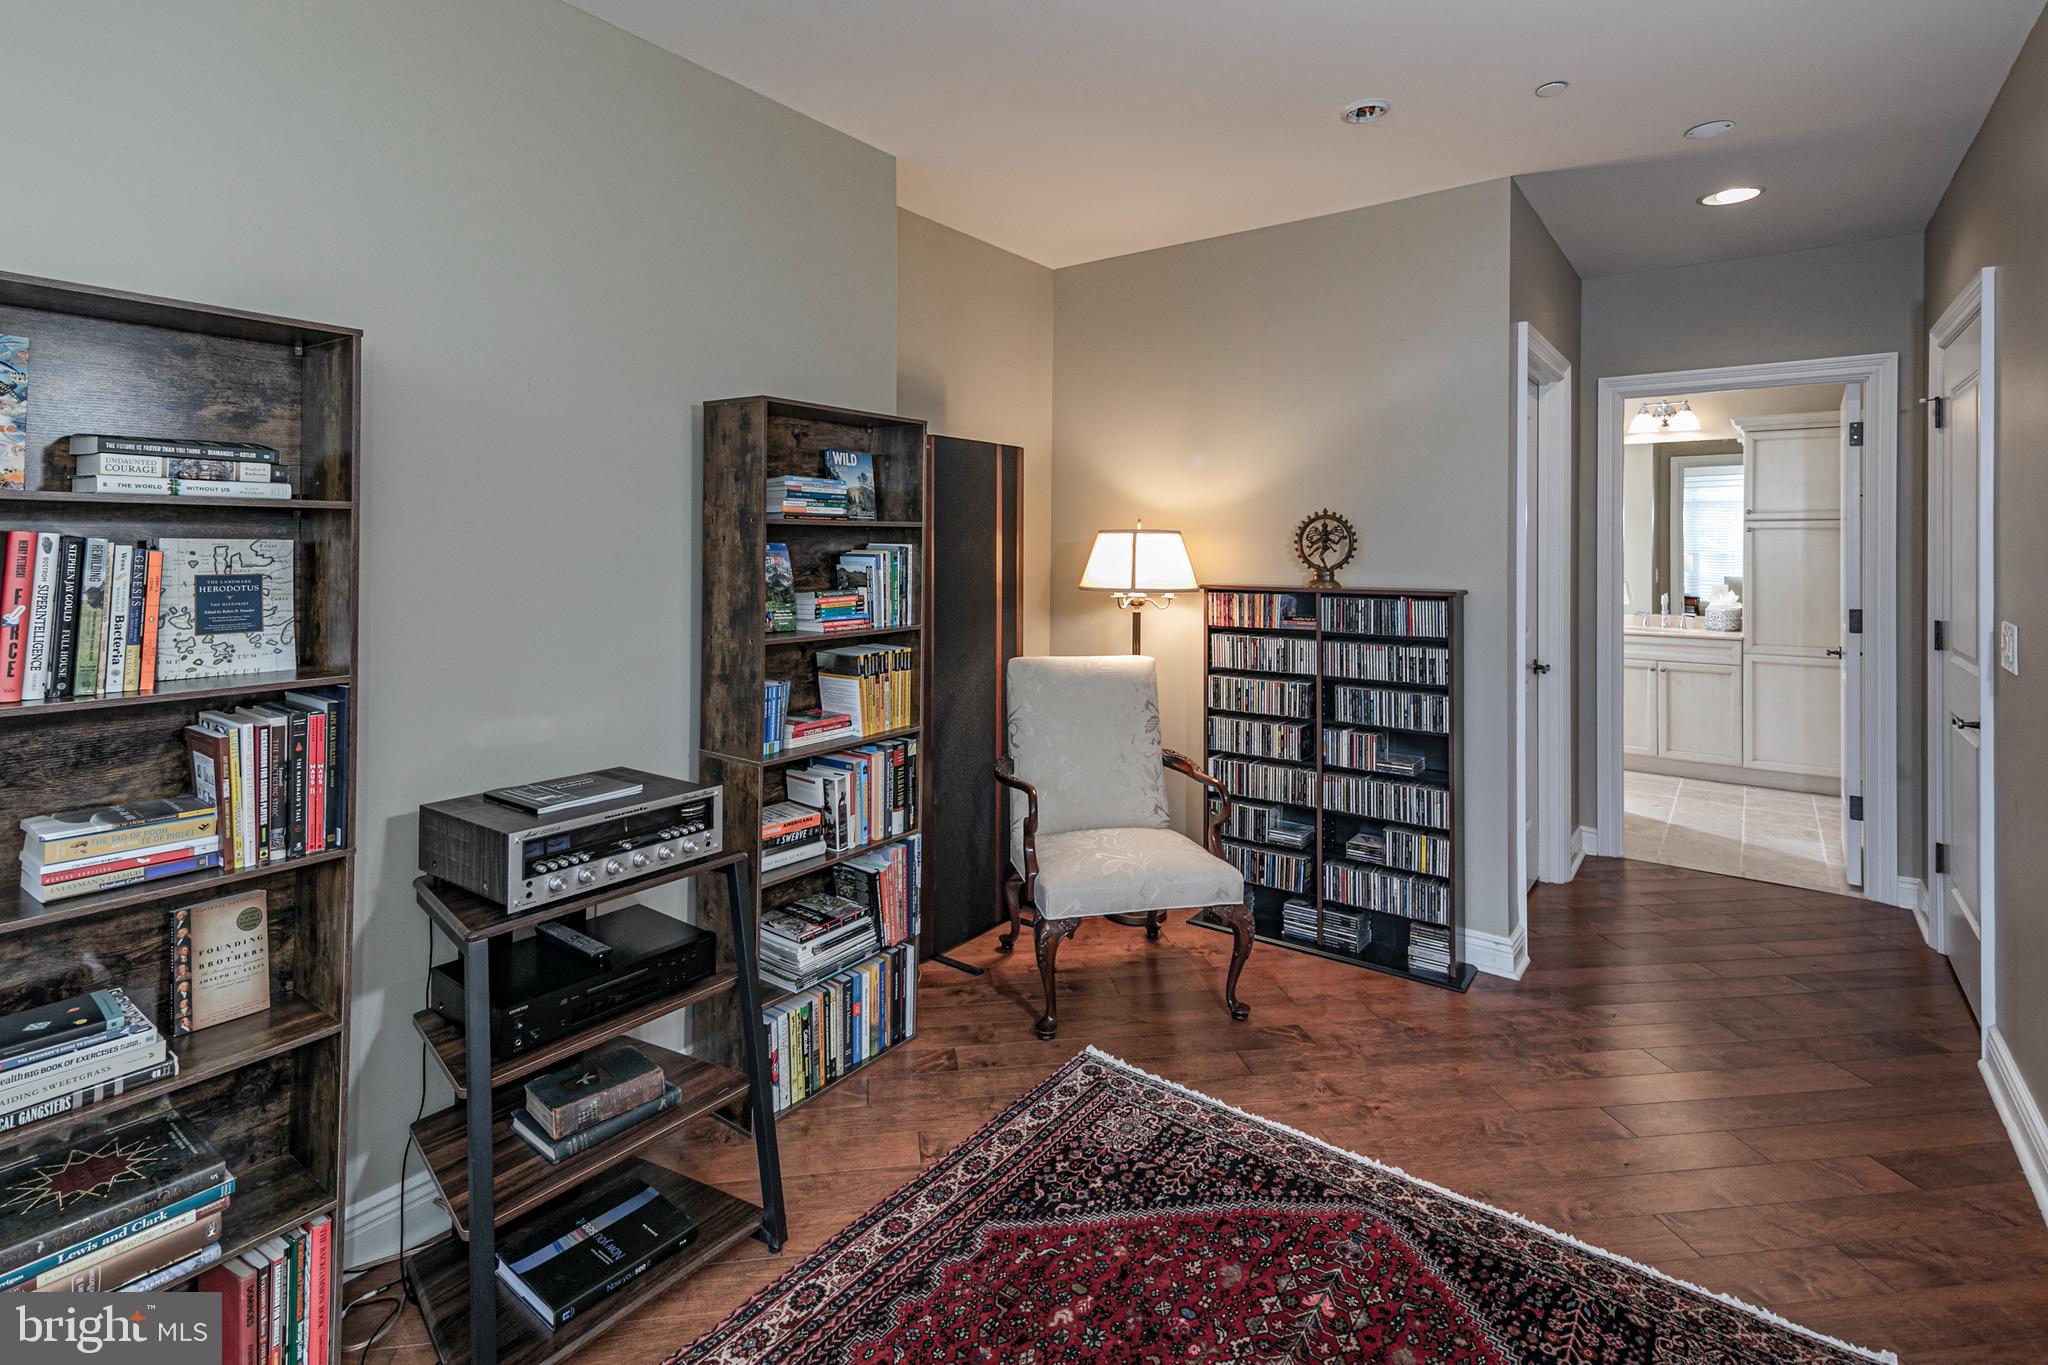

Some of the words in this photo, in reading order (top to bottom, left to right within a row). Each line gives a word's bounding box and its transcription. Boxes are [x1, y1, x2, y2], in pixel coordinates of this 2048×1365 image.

[116, 443, 136, 451] FUTURE
[104, 464, 157, 474] COURAGE
[105, 457, 157, 466] UNDAUNTED
[832, 452, 857, 466] WILD
[18, 540, 28, 555] HENRY
[16, 555, 27, 578] PETROSKI
[41, 557, 49, 582] BOSTROM
[67, 544, 77, 580] STEPHEN
[89, 544, 104, 582] REWILDING
[64, 580, 73, 593] JAY
[131, 555, 144, 607] GENESIS
[199, 584, 260, 593] HERODOTUS
[63, 594, 73, 622] GOULD
[7, 588, 23, 678] FRCE
[30, 584, 49, 671] SUPERINTELLIGENCE
[60, 629, 71, 649] FULL
[111, 615, 125, 665] Bacteria
[58, 651, 68, 678] HOUSE
[897, 767, 905, 806] VALUATION
[783, 817, 813, 827] AMERICANA
[91, 838, 108, 846] THE
[112, 834, 127, 842] TAO
[144, 827, 168, 836] POOH
[153, 834, 164, 842] OF
[167, 829, 195, 840] PIGLET
[781, 830, 807, 844] SWERVE
[50, 878, 104, 893] EVERYMAN'S
[107, 869, 142, 882] TALMUD
[100, 881, 126, 889] Abraham
[127, 876, 145, 885] Cohen
[199, 934, 263, 957] FOUNDING
[199, 948, 265, 970] BROTHERS
[200, 973, 230, 985] JOSEPH
[0, 1073, 24, 1087] ealth
[24, 1069, 40, 1078] BIG
[40, 1061, 63, 1073] BOOK
[64, 1058, 74, 1066] OF
[75, 1045, 119, 1064] EXERCISES
[0, 1089, 39, 1106] AIDING
[42, 1065, 112, 1093] SWEETGRASS
[0, 1117, 16, 1132] CAL
[18, 1095, 72, 1125] GANGSTERS
[57, 1242, 98, 1264] Lewis
[102, 1227, 127, 1246] and
[132, 1211, 168, 1231] Clark
[582, 1222, 598, 1236] see
[593, 1233, 614, 1246] you
[605, 1242, 627, 1261] Now
[607, 1281, 622, 1292] Now
[622, 1272, 635, 1284] you
[635, 1263, 647, 1275] see
